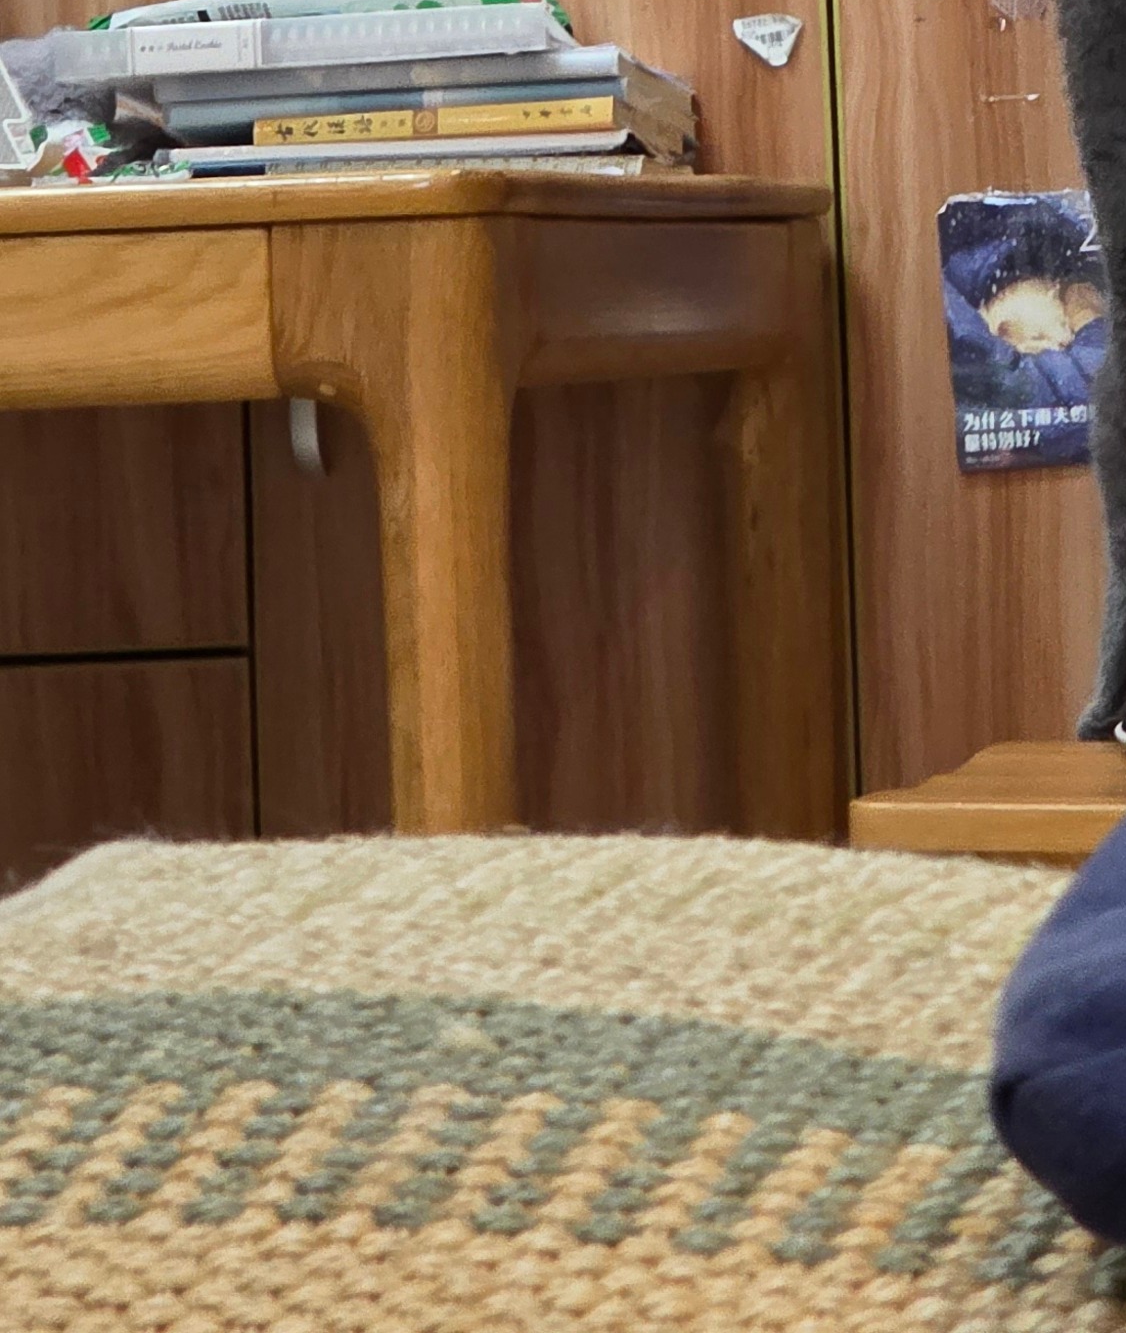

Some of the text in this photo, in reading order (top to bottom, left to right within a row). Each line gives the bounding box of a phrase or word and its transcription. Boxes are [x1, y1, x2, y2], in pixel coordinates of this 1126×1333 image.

[964, 403, 1093, 432] 为什么下雨天的
